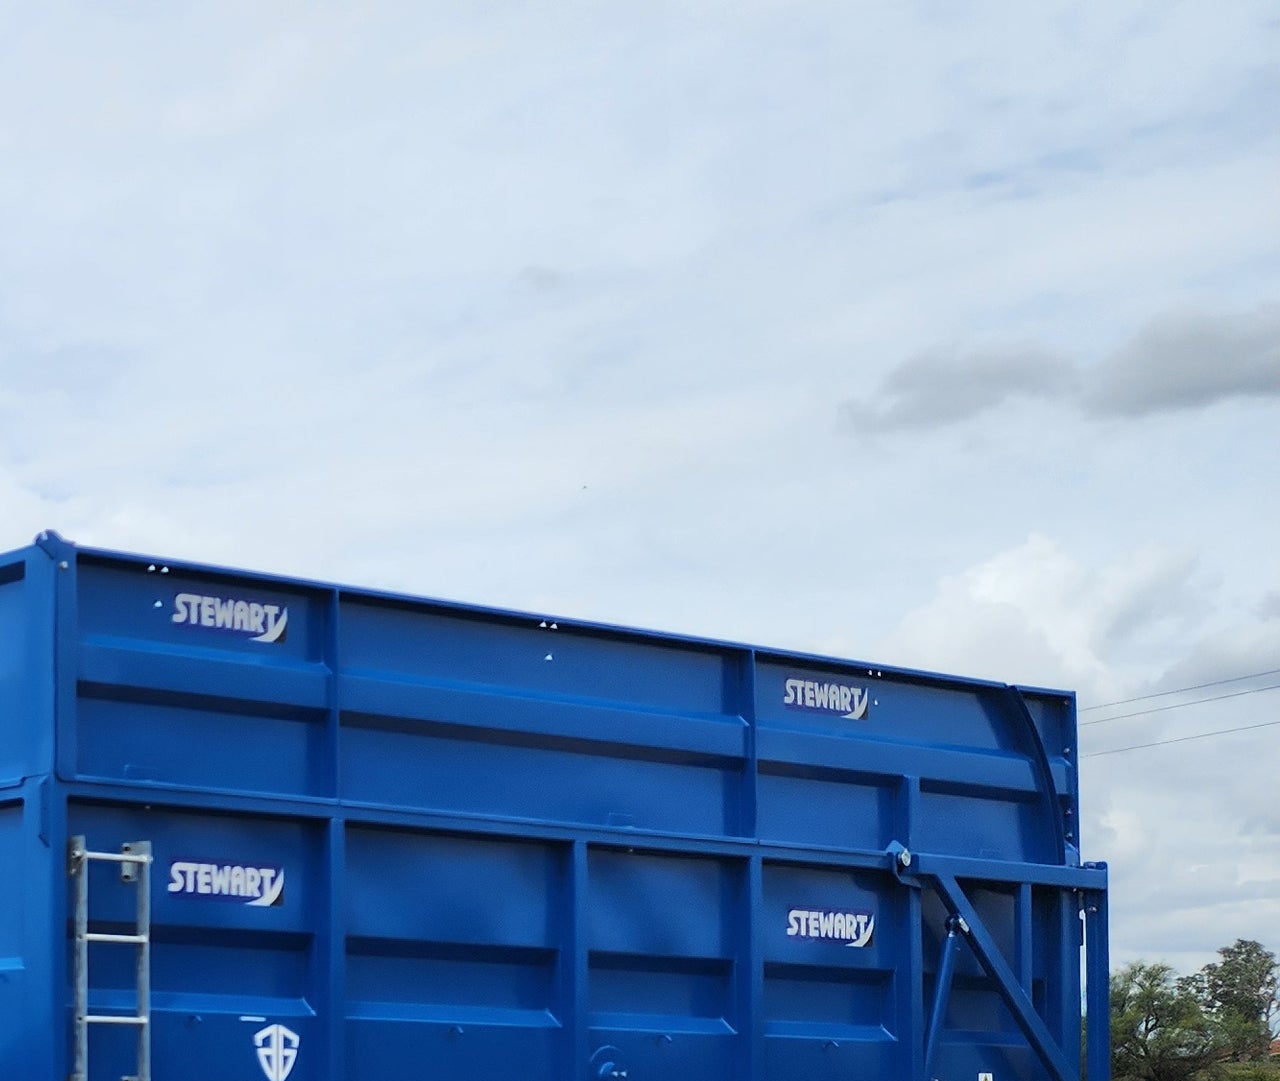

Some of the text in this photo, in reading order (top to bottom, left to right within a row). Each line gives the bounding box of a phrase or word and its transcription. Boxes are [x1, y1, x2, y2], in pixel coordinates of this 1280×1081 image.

[172, 593, 288, 643] STEWART
[784, 678, 868, 720] STEWART
[167, 861, 284, 906] STEWART
[786, 910, 874, 947] STEWART
